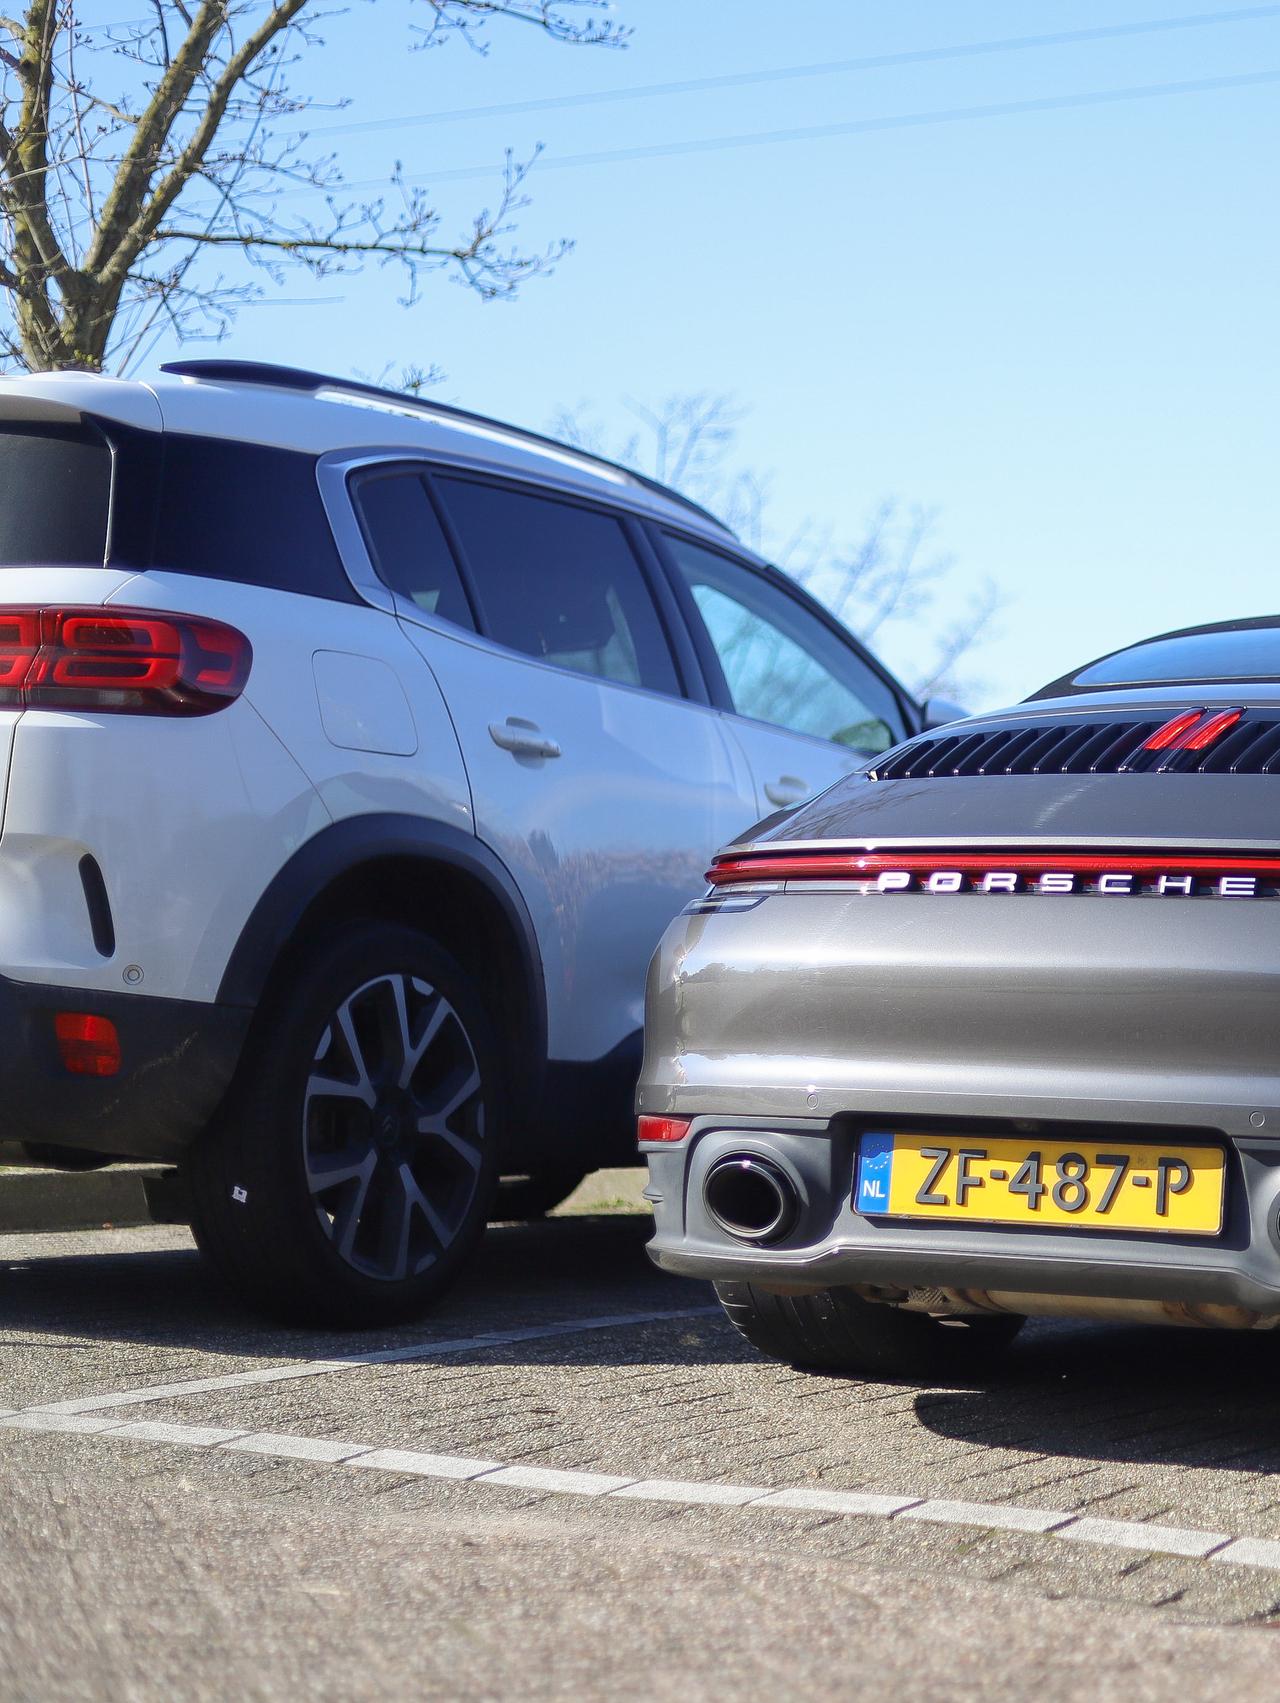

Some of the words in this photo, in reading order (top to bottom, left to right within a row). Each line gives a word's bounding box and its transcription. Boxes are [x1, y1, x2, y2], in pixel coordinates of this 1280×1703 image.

[877, 872, 1257, 896] PORSCHE
[863, 1179, 885, 1199] NL
[916, 1147, 1194, 1216] ZF-487-P
